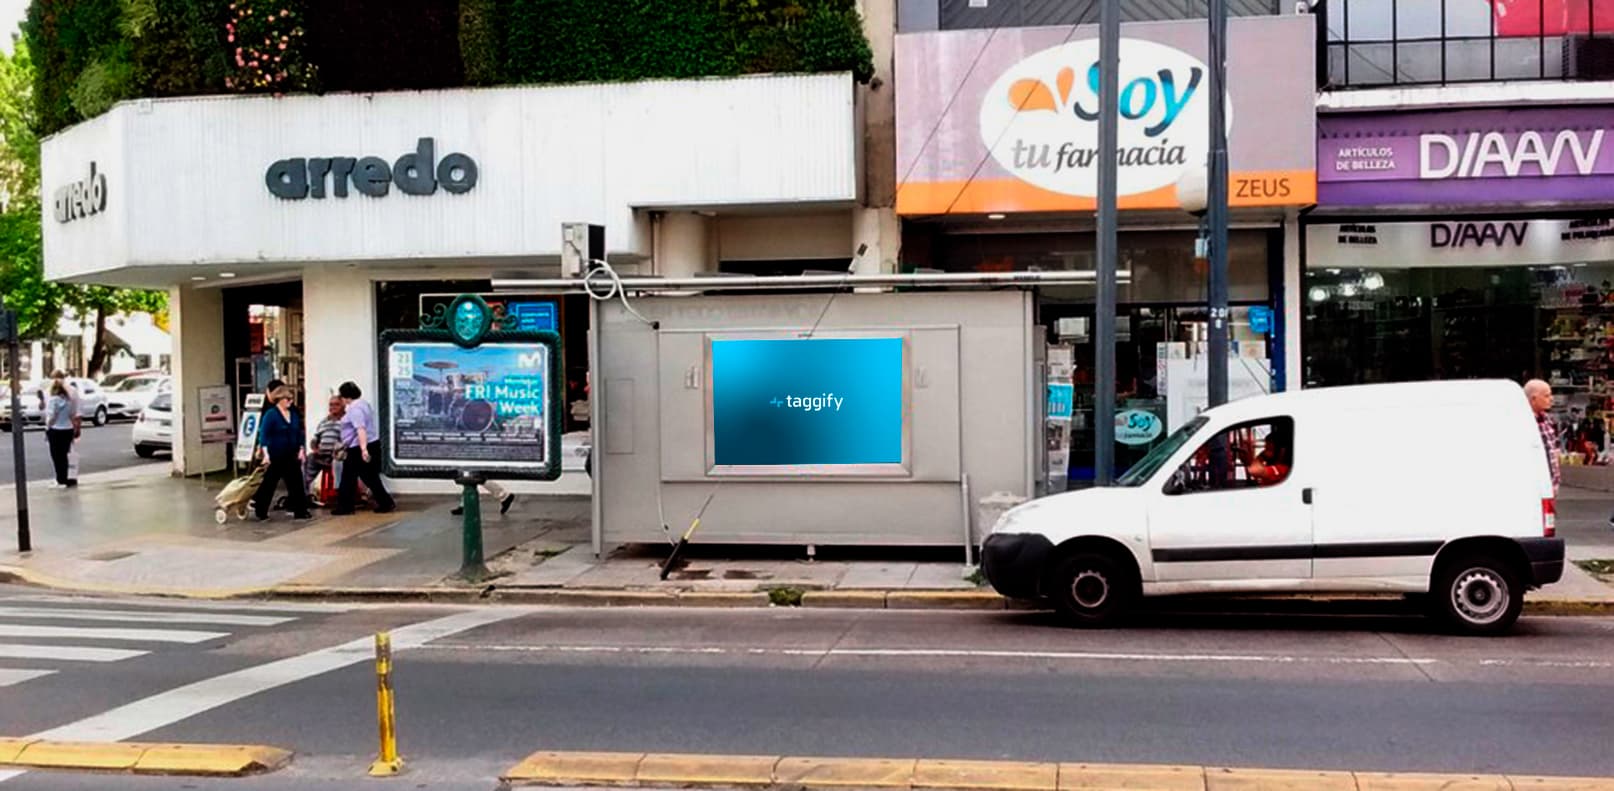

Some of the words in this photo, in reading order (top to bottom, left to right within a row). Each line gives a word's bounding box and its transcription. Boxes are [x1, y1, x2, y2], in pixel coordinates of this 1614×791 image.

[1074, 60, 1203, 137] Soy
[1011, 139, 1051, 169] tu
[266, 137, 478, 200] arredo
[1336, 161, 1349, 171] DE
[1351, 159, 1396, 171] BELLEZA
[54, 161, 107, 224] arredo
[1236, 178, 1291, 198] ZEUS
[465, 384, 491, 399] FRI
[495, 383, 540, 399] Music
[500, 401, 540, 415] Week
[785, 392, 844, 412] taggify
[1128, 413, 1156, 432] Soy
